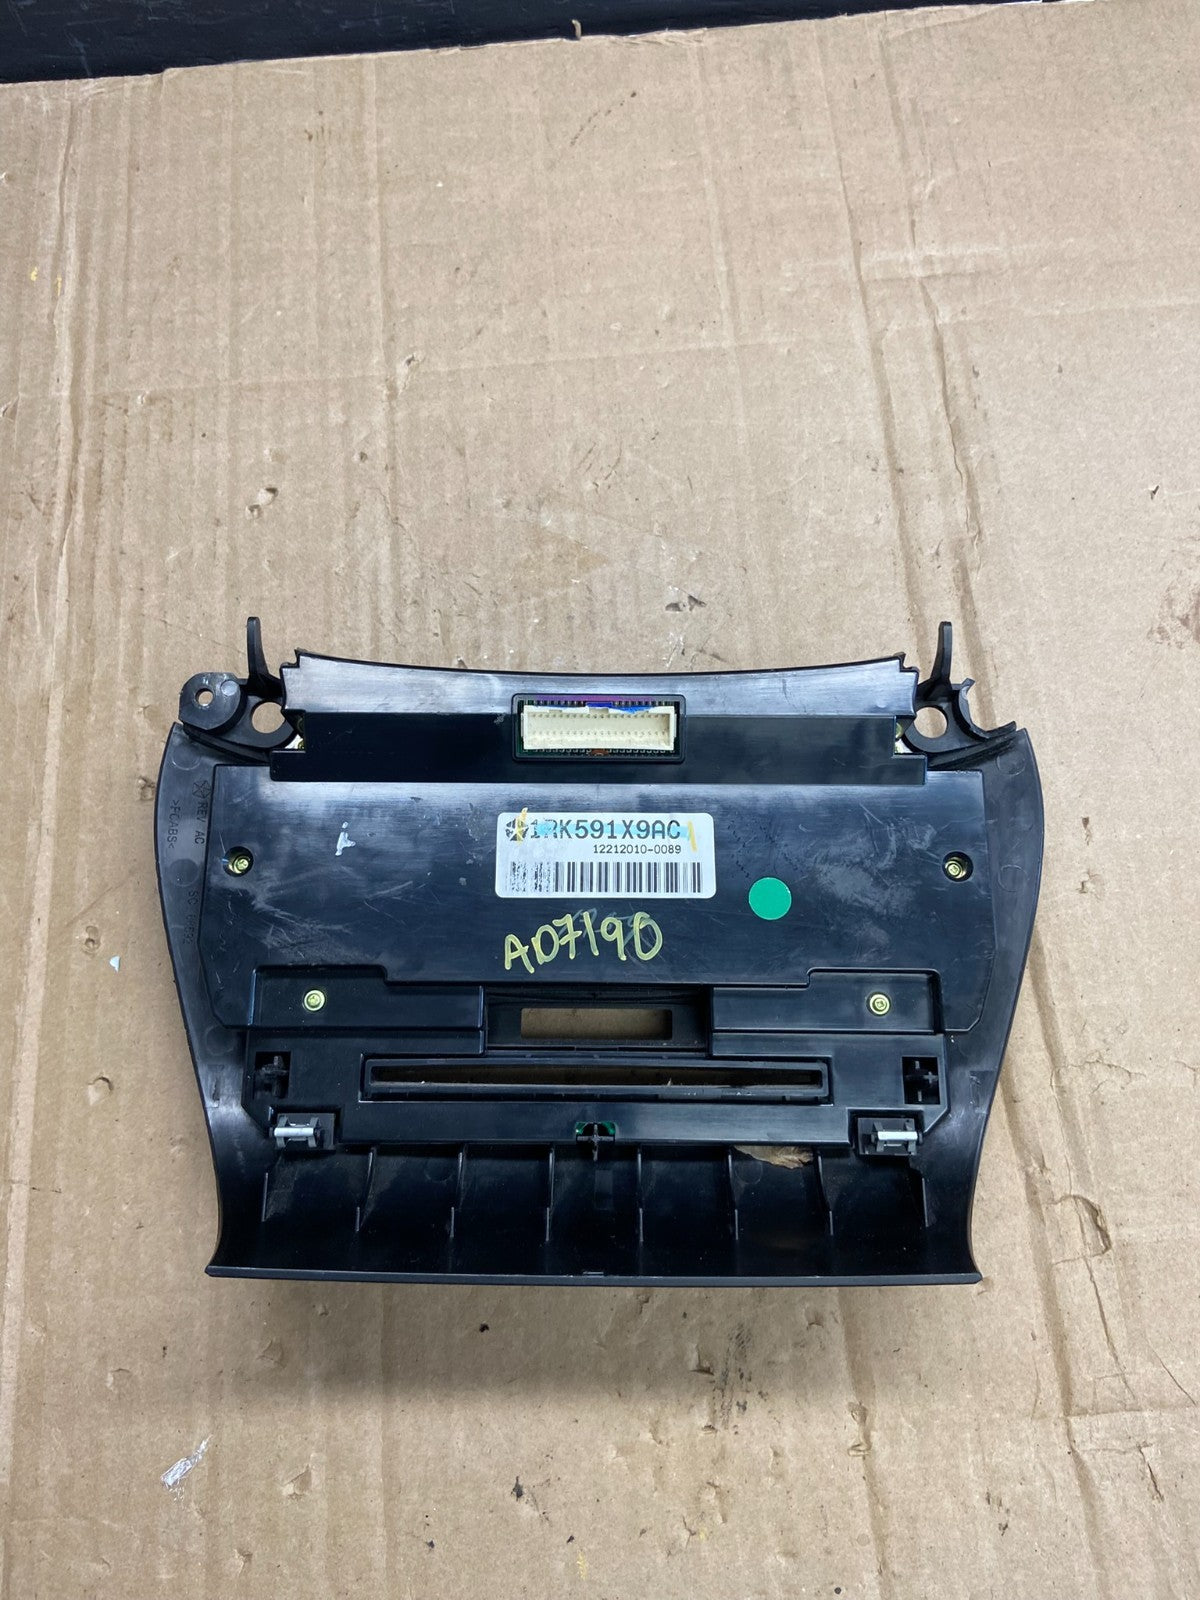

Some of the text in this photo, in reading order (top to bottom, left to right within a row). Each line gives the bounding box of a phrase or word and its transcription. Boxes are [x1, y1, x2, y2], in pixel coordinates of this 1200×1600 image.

[194, 800, 208, 845] REV AC
[593, 844, 682, 854] 12212010-0089
[504, 911, 663, 974] A07190
